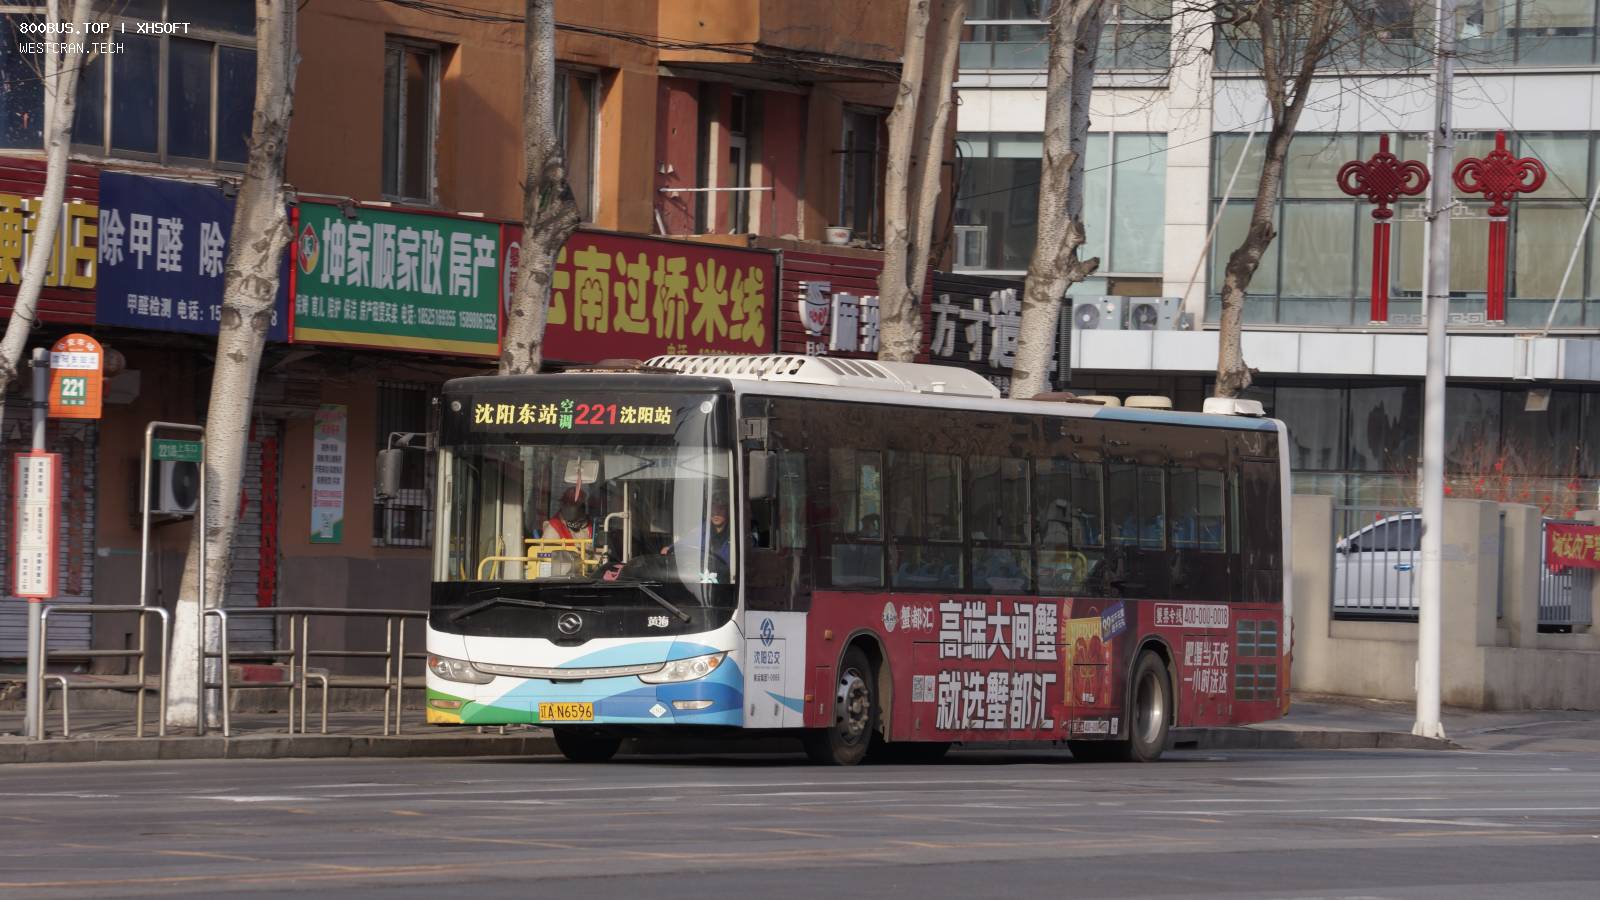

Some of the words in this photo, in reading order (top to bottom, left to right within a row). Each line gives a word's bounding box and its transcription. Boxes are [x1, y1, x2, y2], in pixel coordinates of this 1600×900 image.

[98, 209, 184, 273] 除甲醛
[321, 217, 444, 295] 坤家顺家政
[449, 231, 496, 298] 房产
[127, 293, 172, 319] 甲醛检测
[62, 378, 86, 397] 221
[474, 403, 559, 425] 沈阳东站
[574, 403, 617, 425] 221
[619, 405, 672, 425] 沈阳站
[939, 600, 1058, 661] 高端大闸蟹
[753, 650, 781, 665] 沈阳公交
[1183, 668, 1227, 694] 一小时送达
[935, 670, 1057, 730] 就选蟹都汇
